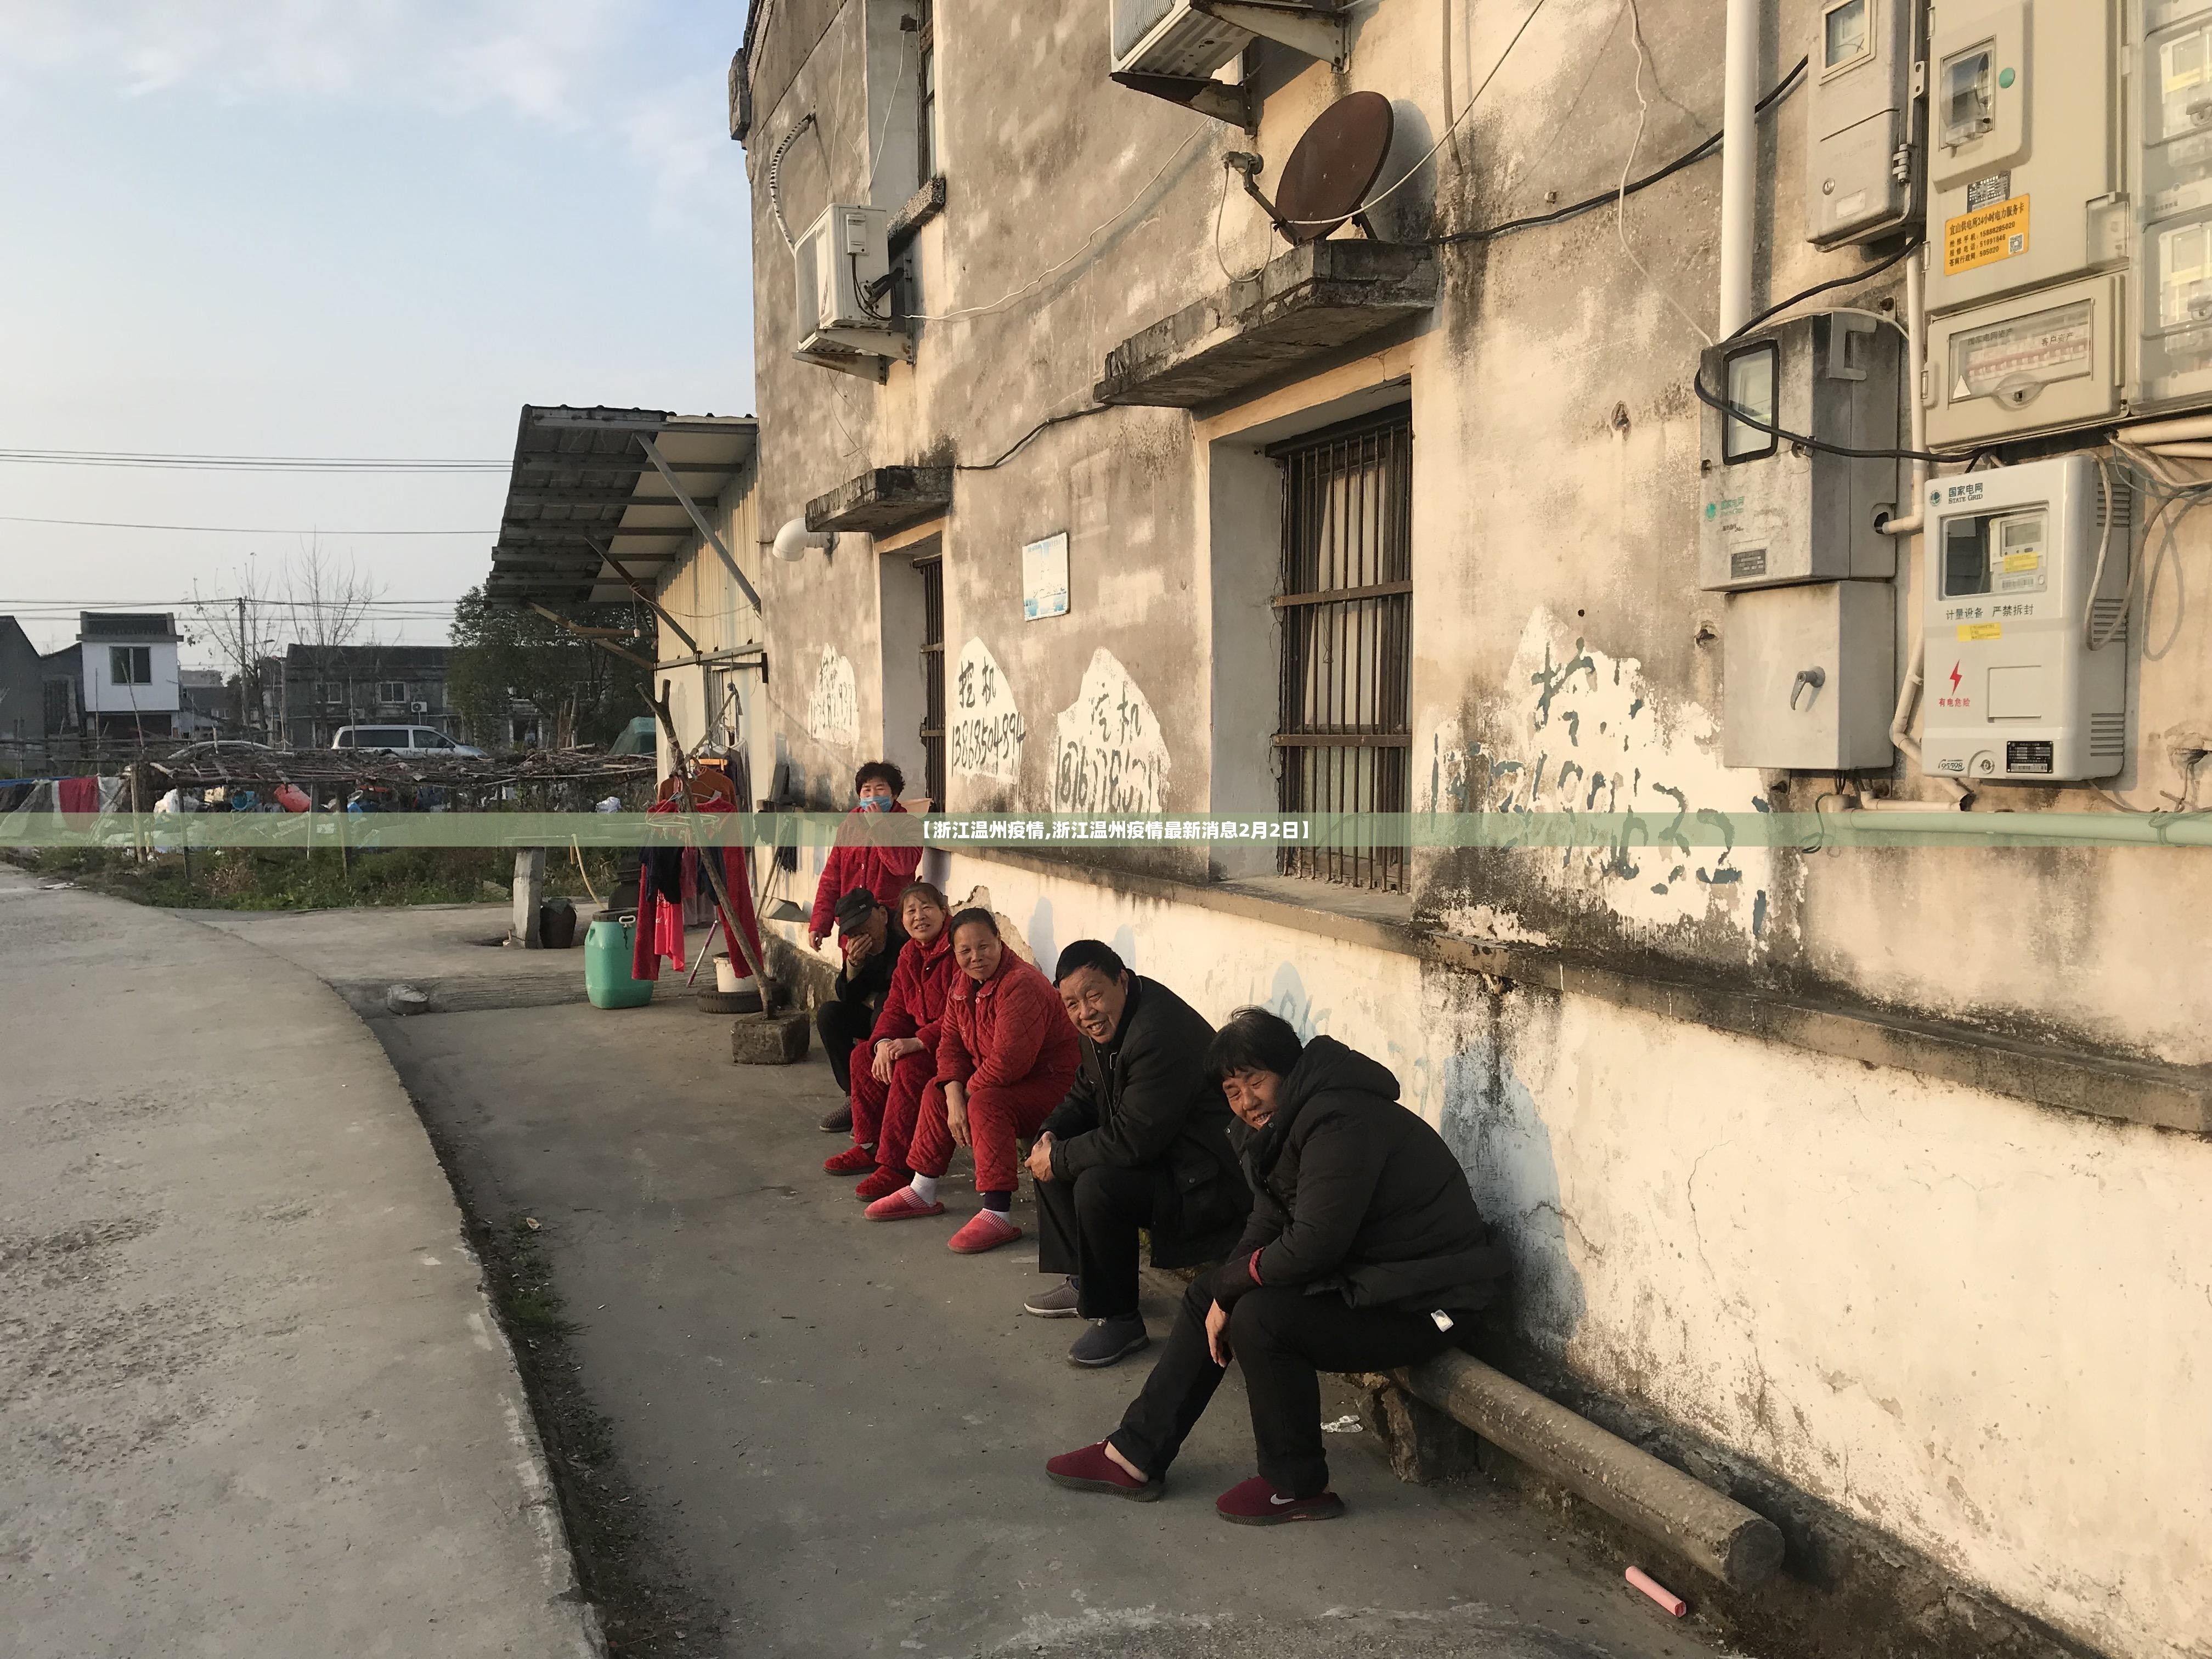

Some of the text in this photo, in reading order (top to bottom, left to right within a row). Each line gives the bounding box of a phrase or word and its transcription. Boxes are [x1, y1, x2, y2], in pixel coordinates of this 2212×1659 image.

[2041, 332, 2074, 347] 客户资产
[1949, 483, 1983, 498] 国家电网
[1946, 604, 2034, 620] 计量设备 严禁拆封
[958, 656, 996, 709] 挖机
[1939, 698, 1971, 707] 有电危险
[951, 712, 1026, 778] 13868504894
